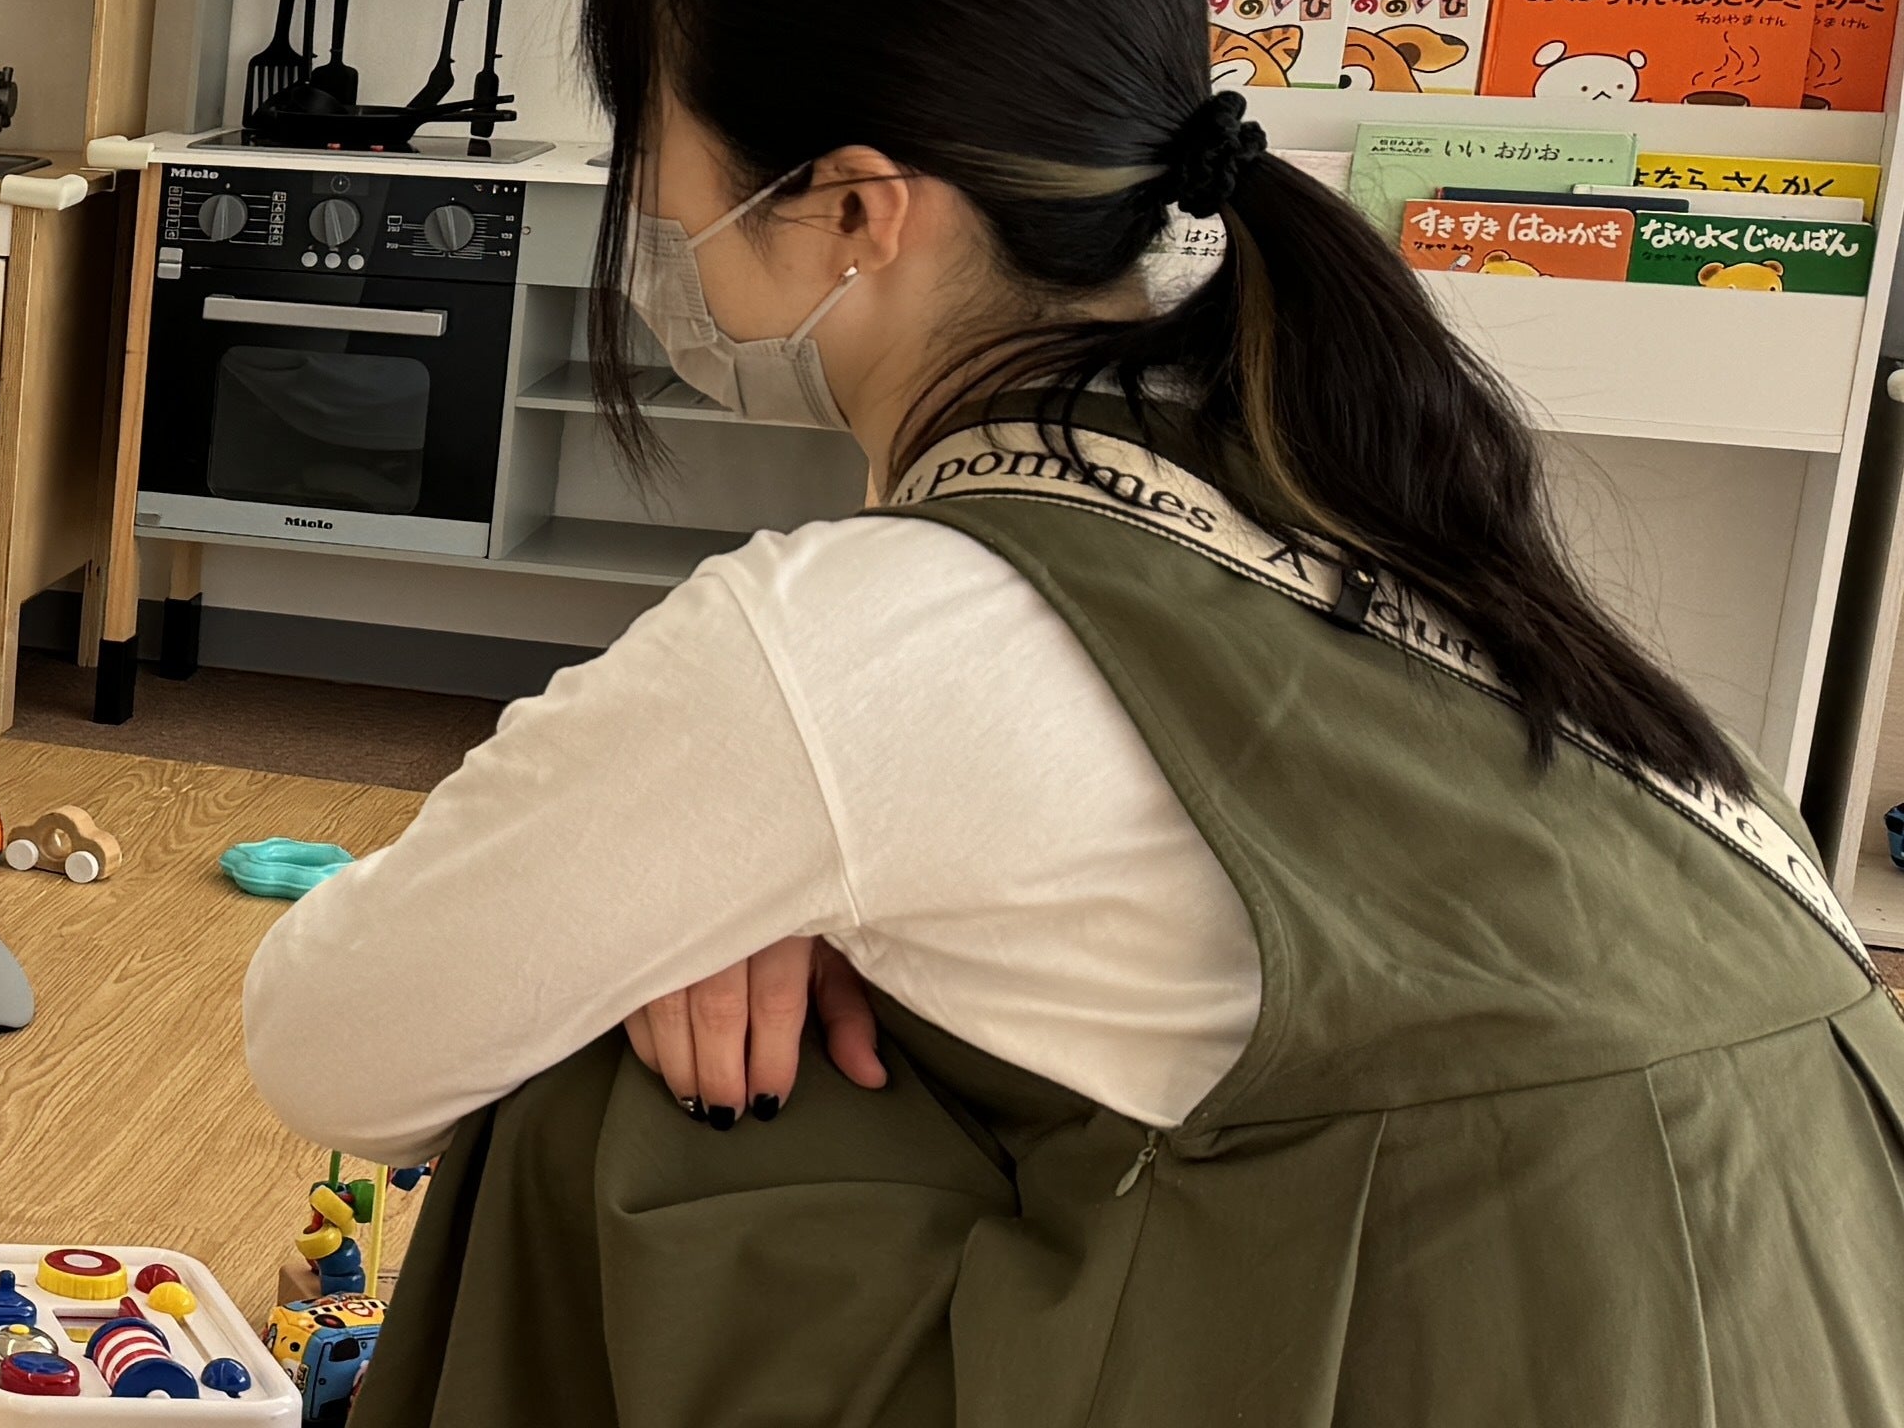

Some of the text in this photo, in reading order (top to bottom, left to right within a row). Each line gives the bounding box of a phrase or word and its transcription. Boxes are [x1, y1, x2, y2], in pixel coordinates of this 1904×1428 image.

[1494, 141, 1561, 162] おかお
[1184, 229, 1226, 244] はら
[926, 447, 1219, 534] pommes
